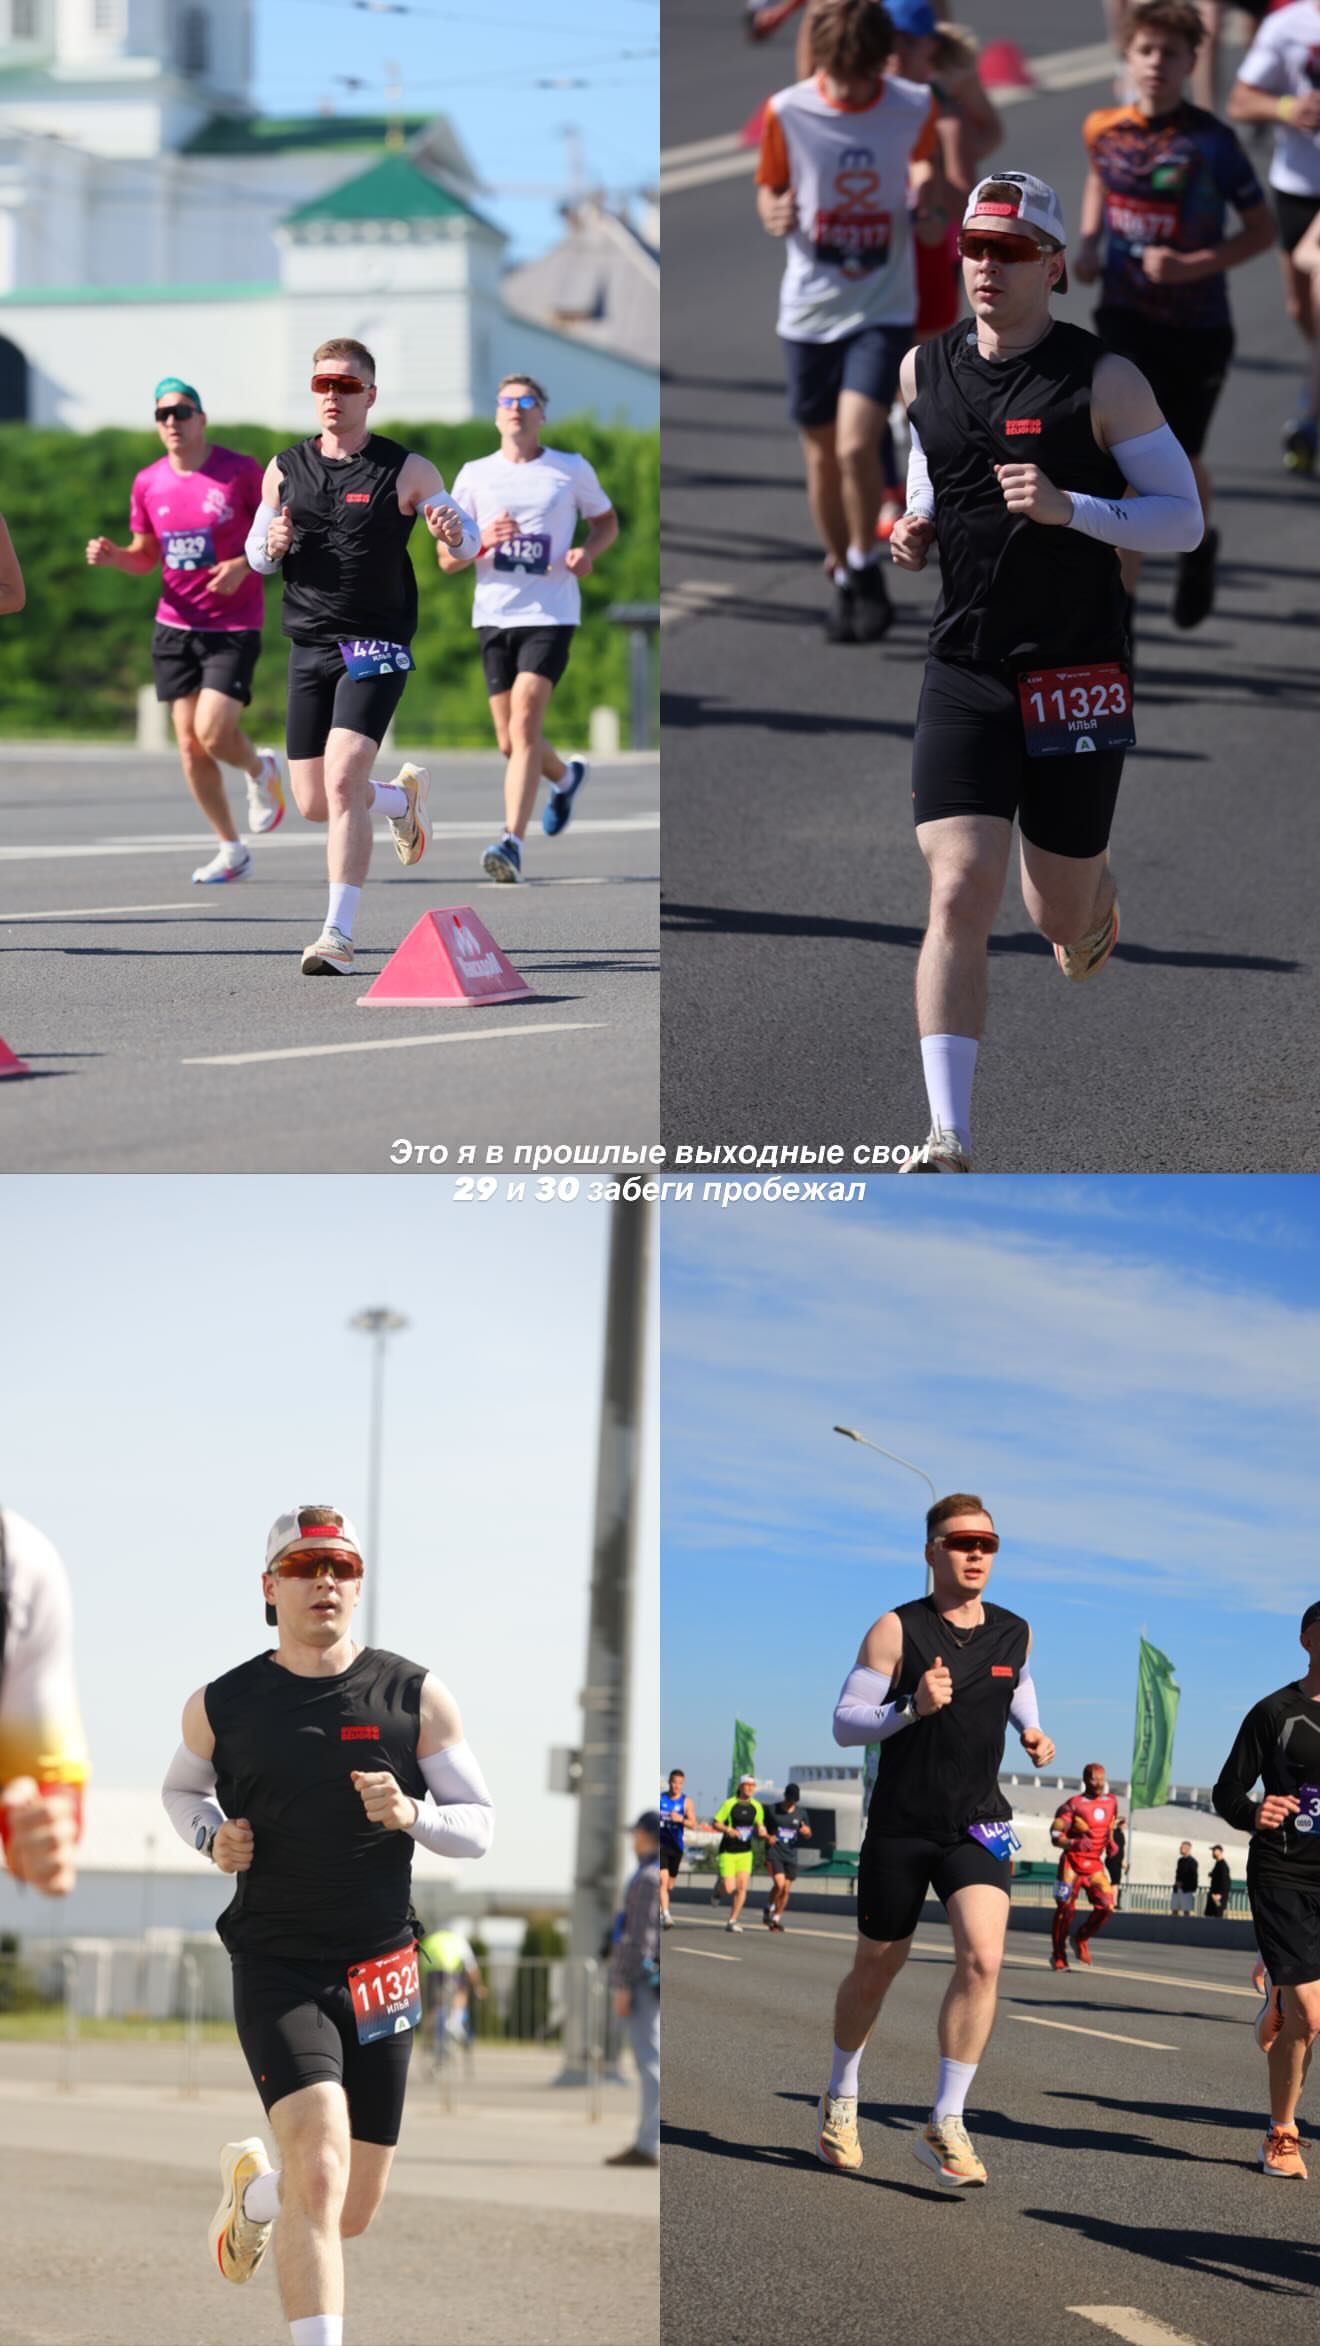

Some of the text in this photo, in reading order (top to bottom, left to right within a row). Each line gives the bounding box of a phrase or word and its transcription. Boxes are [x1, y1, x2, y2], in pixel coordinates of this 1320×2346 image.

[500, 540, 543, 559] 4120
[1030, 682, 1126, 722] 11323
[1067, 719, 1098, 731] ИЛЬЯ
[357, 1960, 419, 2012] 11323
[386, 1998, 410, 2015] ИЛЬЯ
